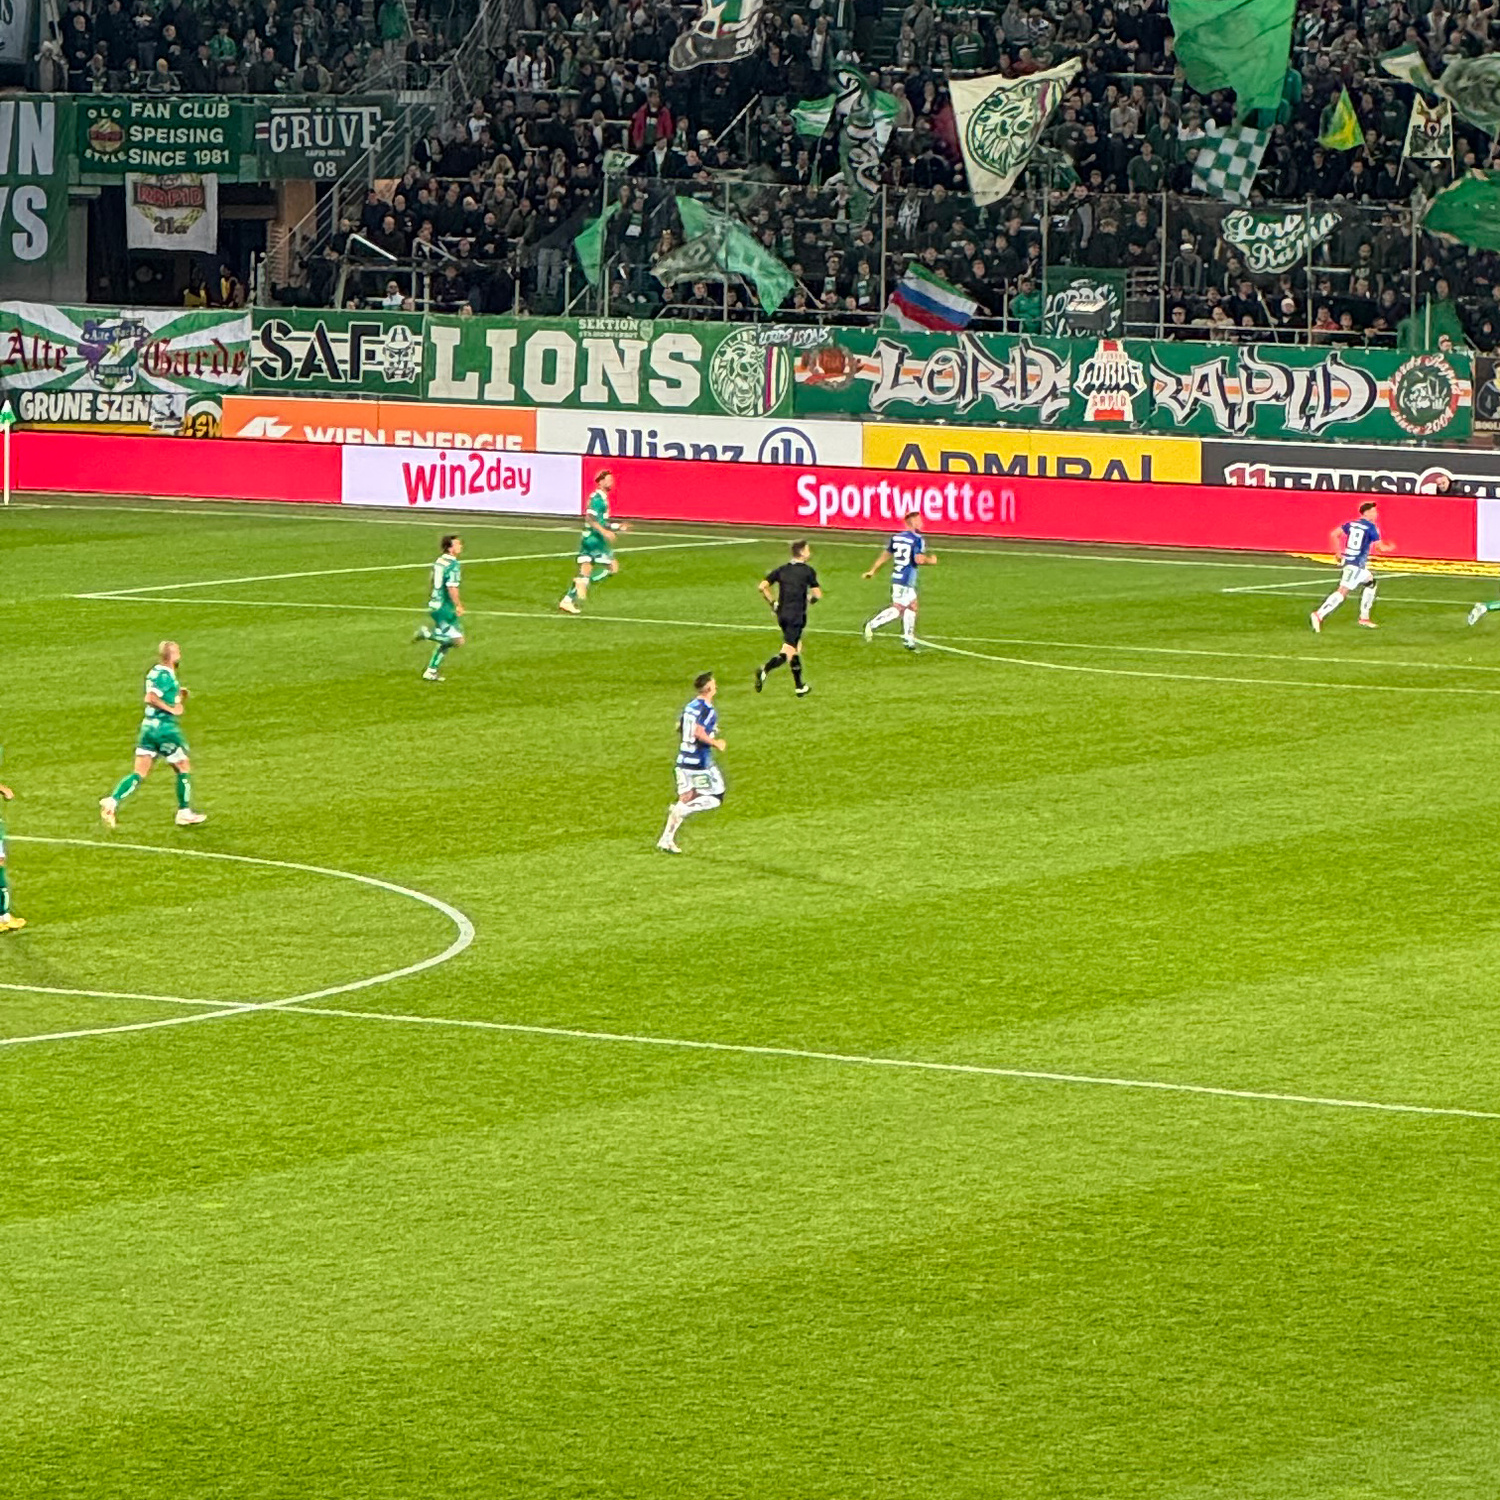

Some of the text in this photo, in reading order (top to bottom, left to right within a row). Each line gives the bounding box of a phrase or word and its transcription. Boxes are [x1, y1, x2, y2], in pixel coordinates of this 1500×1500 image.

[87, 108, 122, 119] OLD
[131, 103, 230, 119] FAN CLUB
[129, 126, 224, 144] SPEISING
[84, 149, 128, 164] STYLE
[128, 148, 230, 166] SINCE 1981
[313, 161, 337, 178] 08
[136, 184, 205, 208] RAPID
[578, 319, 640, 331] SEKTION
[3, 327, 247, 378] Alte Garde
[258, 319, 383, 383] SAF
[428, 326, 703, 408] LIONS
[1150, 345, 1378, 436] RAPID
[19, 391, 151, 422] GRÜNE SZEN
[303, 425, 386, 445] WIEN
[586, 426, 744, 463] Allianz
[796, 473, 1016, 526] Sportwetten
